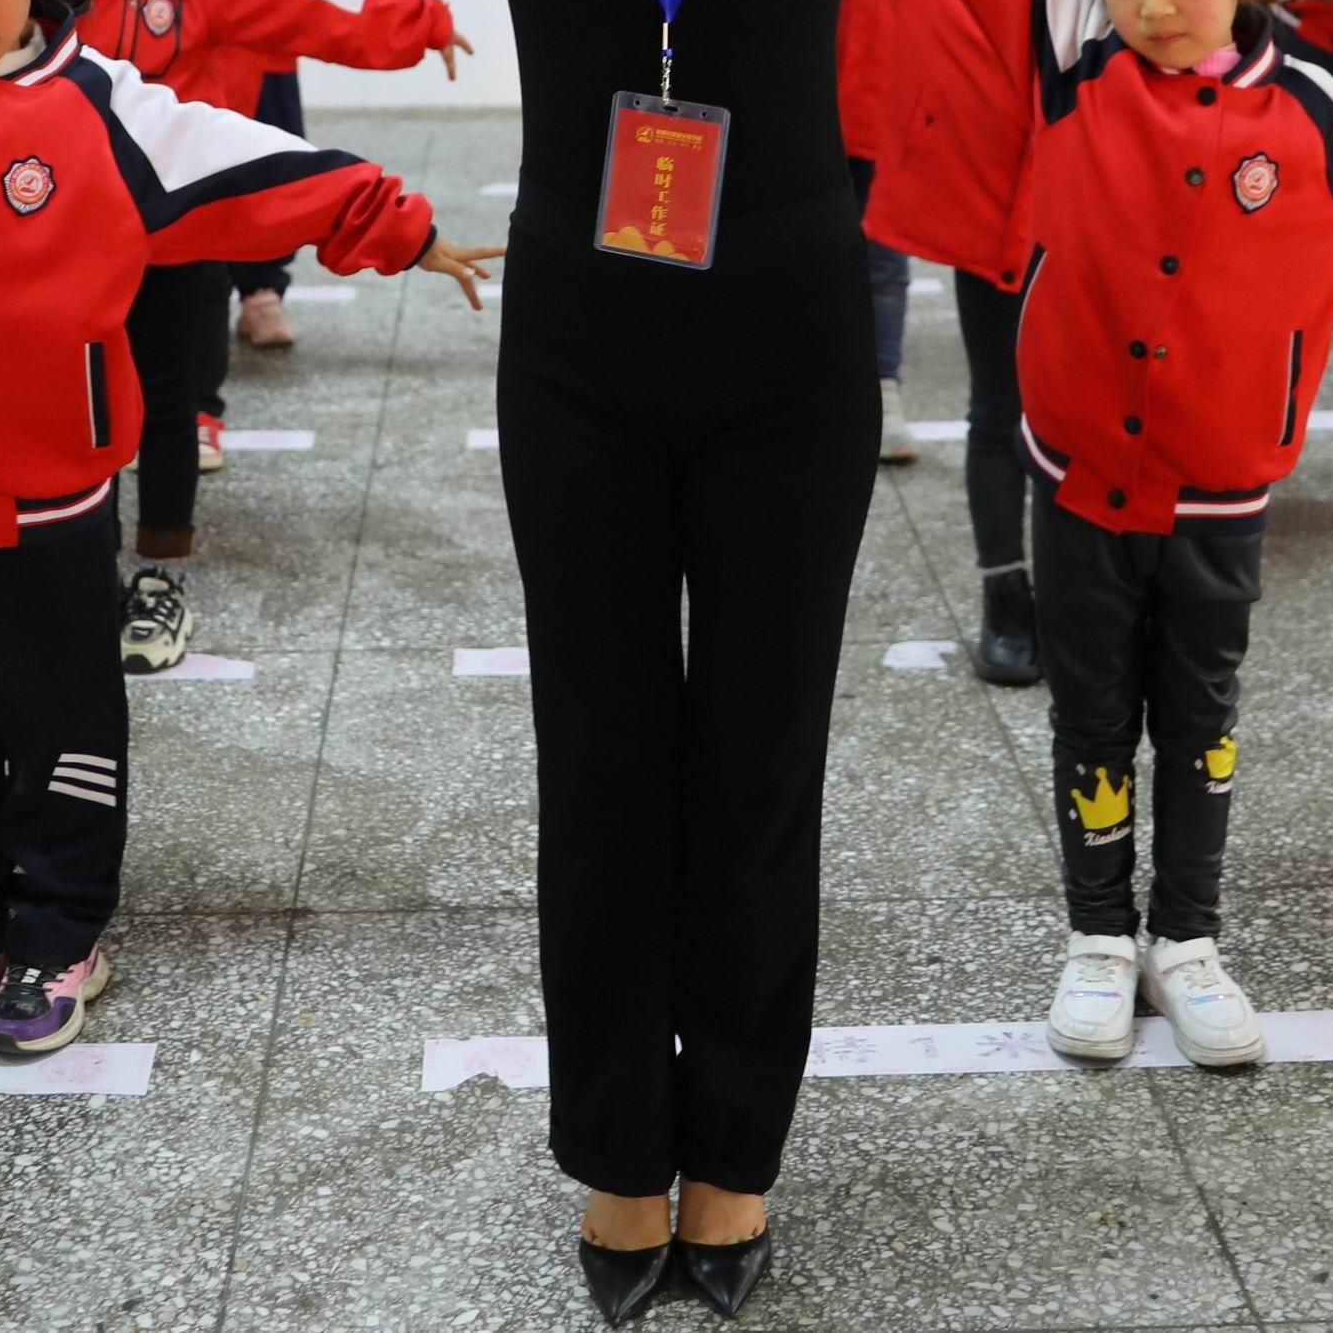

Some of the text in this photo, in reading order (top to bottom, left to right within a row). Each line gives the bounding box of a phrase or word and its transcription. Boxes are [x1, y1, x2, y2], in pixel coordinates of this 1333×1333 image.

[649, 156, 675, 237] 临时工作证
[810, 1029, 1149, 1065] 持1米
